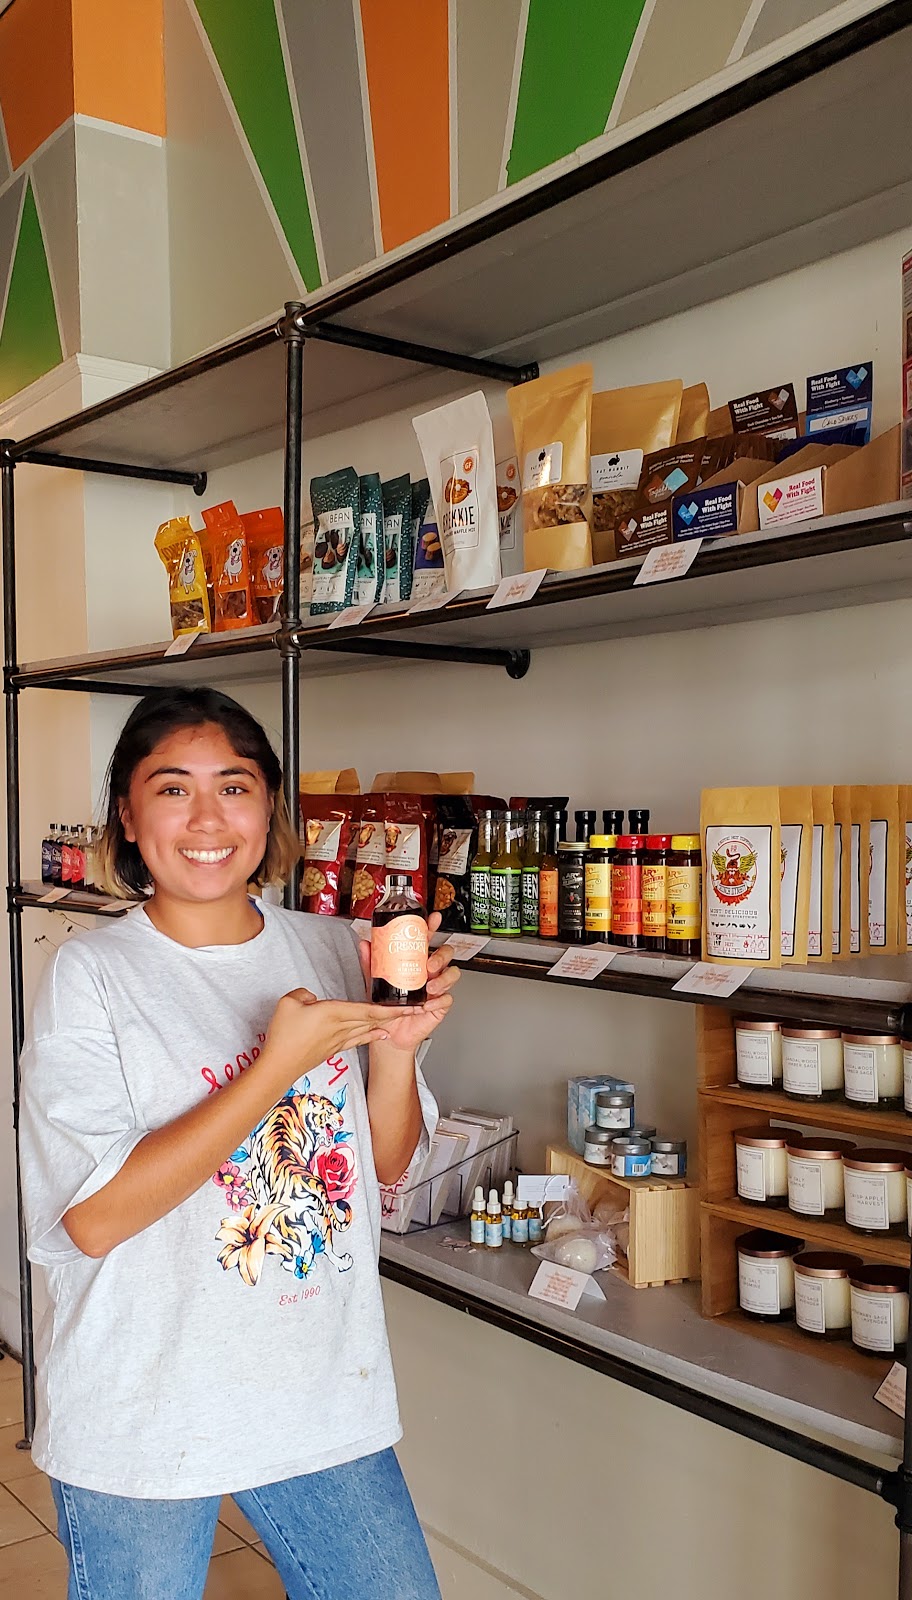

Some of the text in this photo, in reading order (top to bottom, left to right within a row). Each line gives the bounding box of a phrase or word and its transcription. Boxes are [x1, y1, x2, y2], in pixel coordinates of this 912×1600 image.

[811, 374, 837, 386] Real Food
[811, 380, 841, 392] With Fight
[733, 397, 759, 409] Real Food
[734, 407, 748, 415] With
[748, 403, 764, 412] Fight
[788, 478, 816, 492] Real Food
[786, 486, 816, 500] With Fight
[704, 494, 732, 508] Real Food
[702, 502, 732, 514] With Fight
[329, 511, 350, 525] BEAN
[642, 510, 667, 523] Real Food
[640, 522, 652, 530] With
[652, 518, 668, 528] Fight
[279, 1285, 321, 1306] Est 1990
